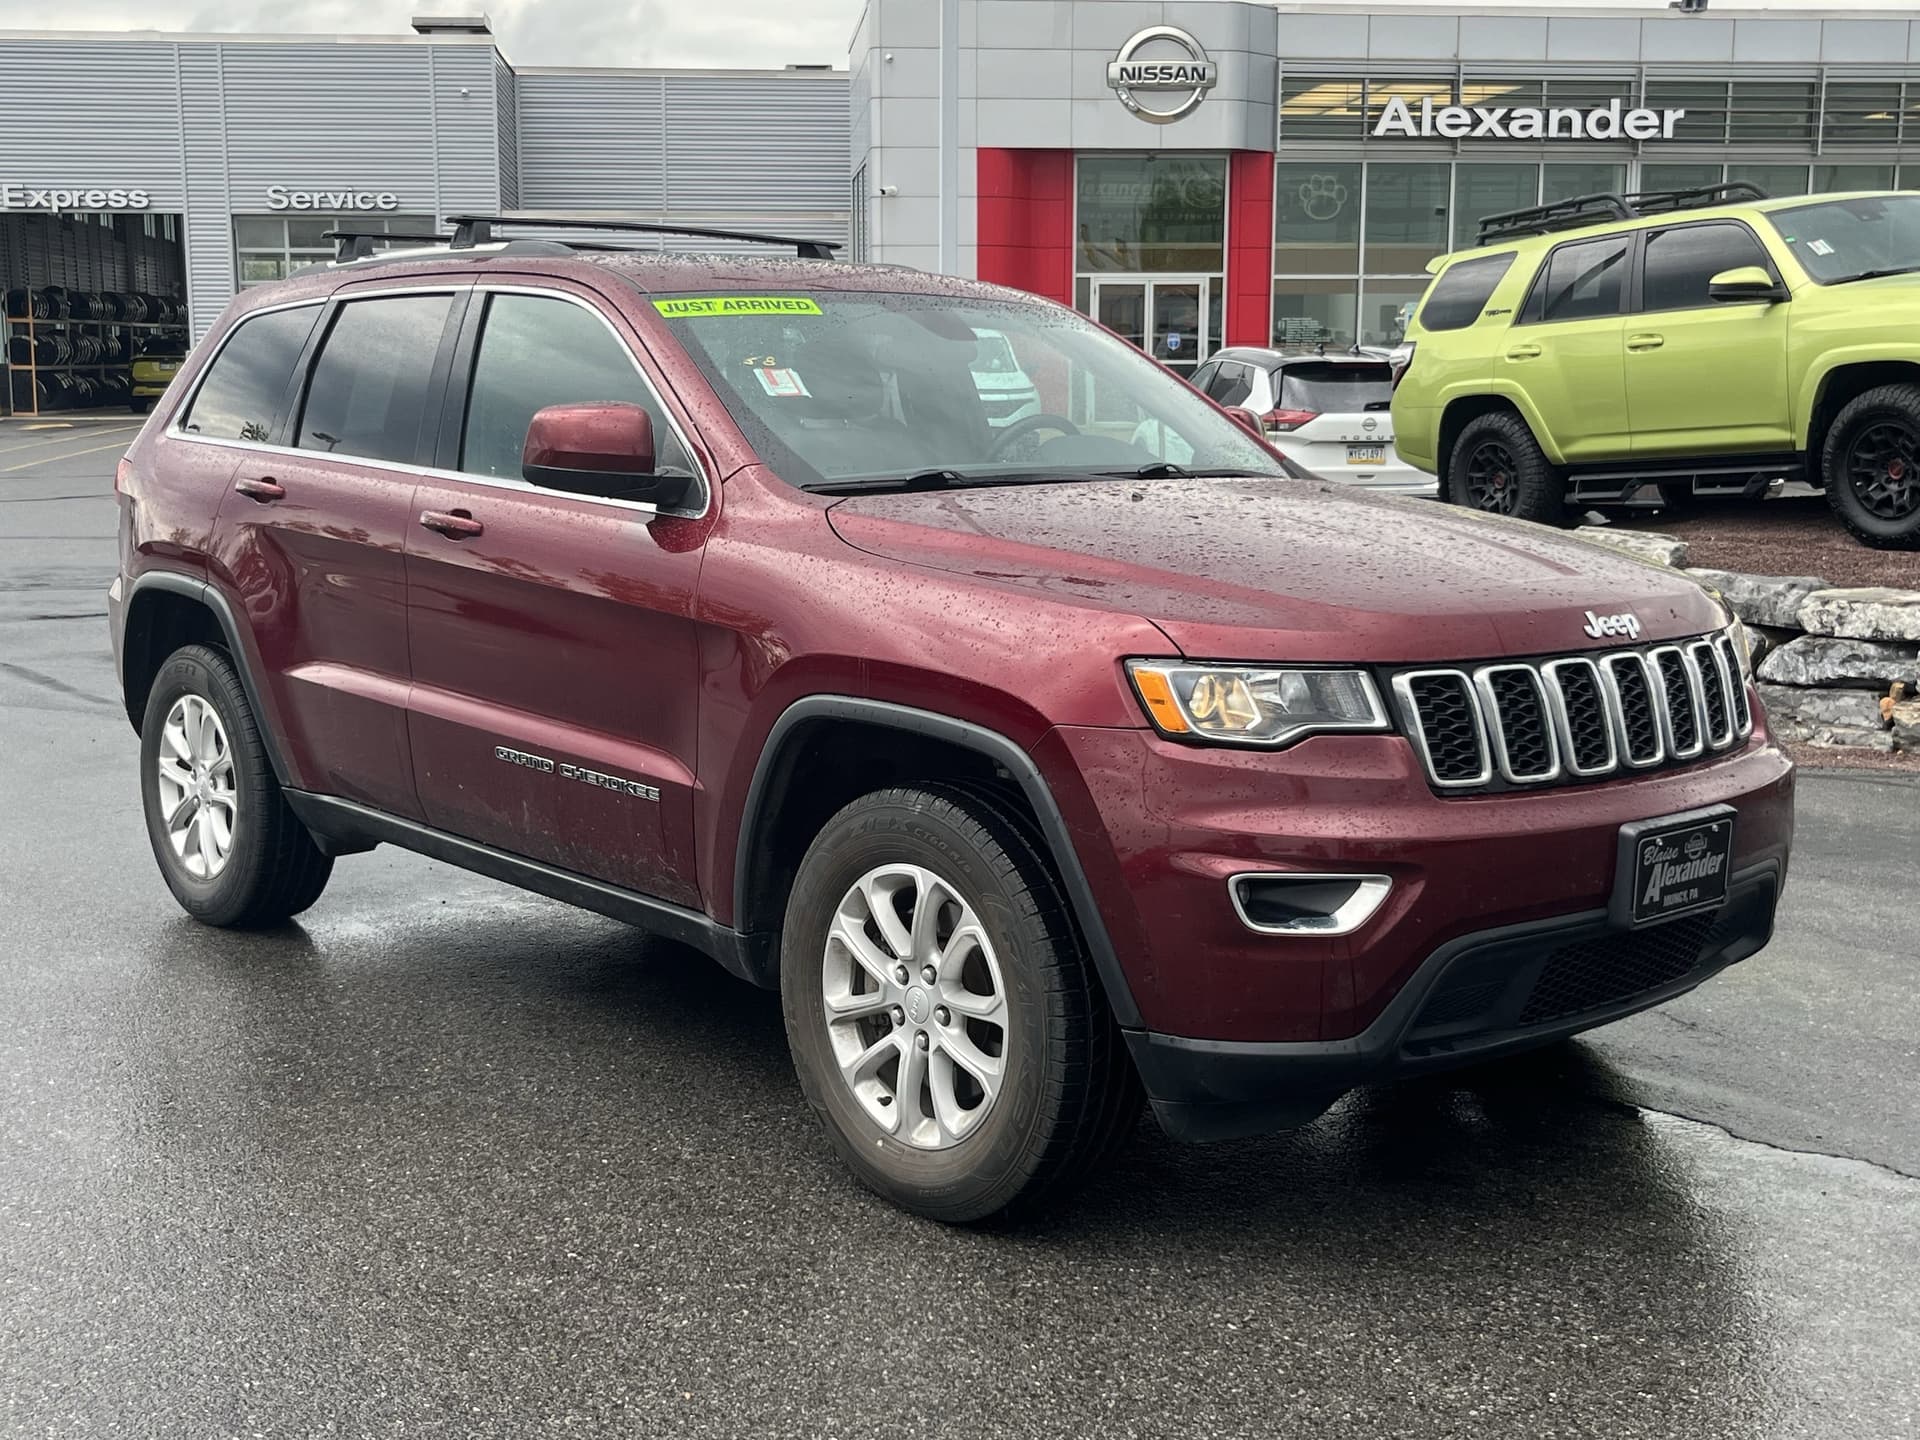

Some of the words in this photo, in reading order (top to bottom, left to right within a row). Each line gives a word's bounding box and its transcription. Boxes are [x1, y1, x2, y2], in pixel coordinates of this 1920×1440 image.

[1120, 66, 1207, 82] NISSAN
[1371, 95, 1686, 139] Alexander
[2, 183, 150, 213] Express
[266, 184, 399, 210] Service
[663, 300, 715, 313] JUST
[722, 299, 811, 311] ARRIVED
[1583, 610, 1640, 640] Jeep
[495, 745, 554, 774] GRAND
[559, 763, 661, 803] CHEROKEE
[1642, 851, 1725, 905] Alexander
